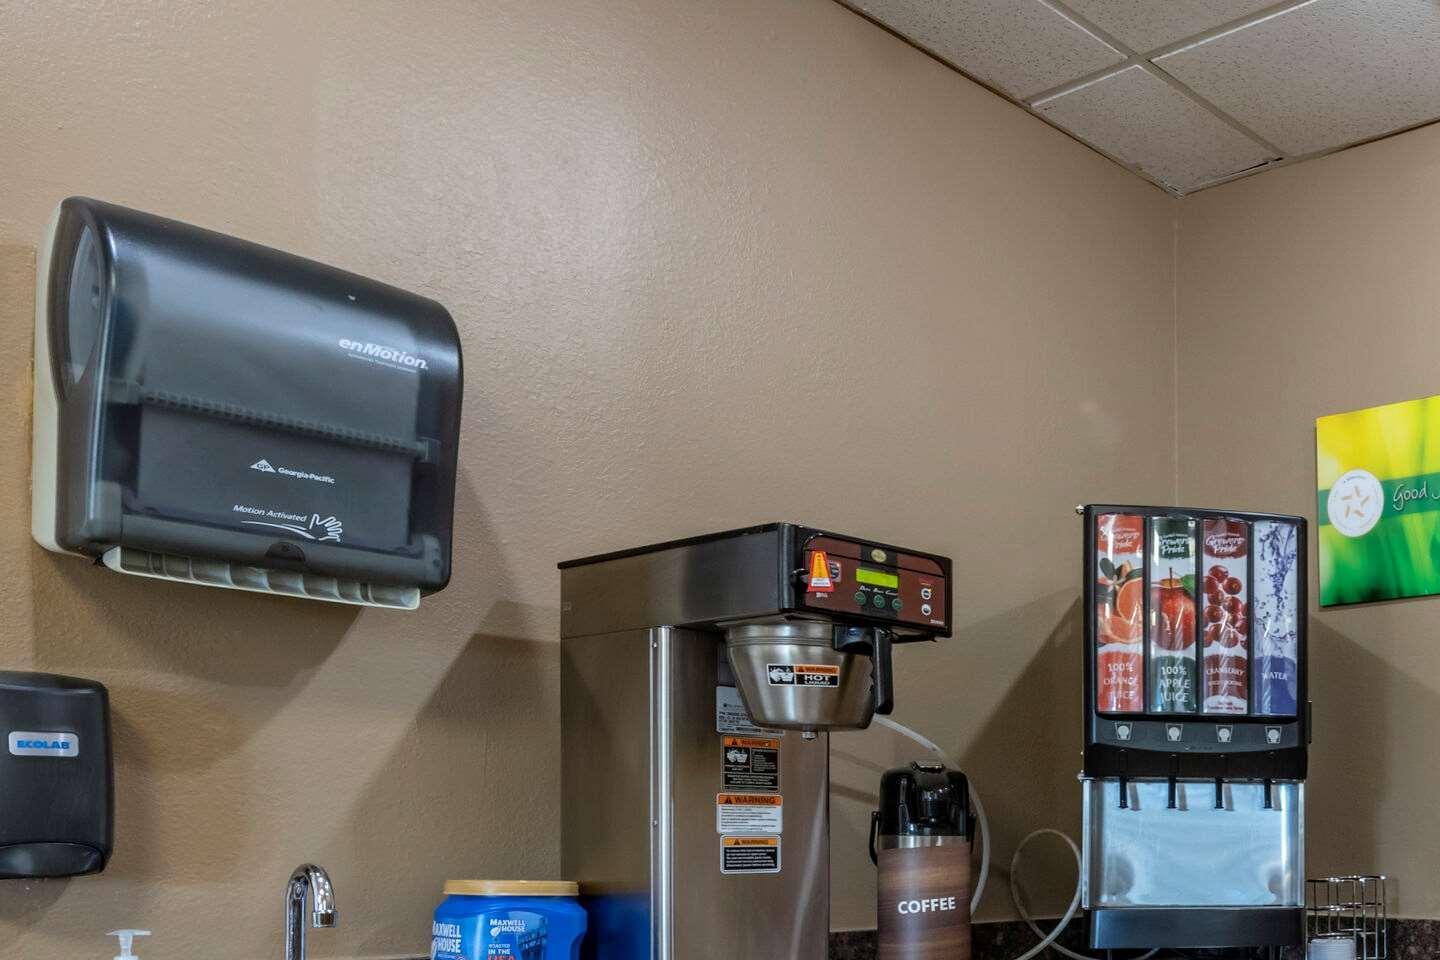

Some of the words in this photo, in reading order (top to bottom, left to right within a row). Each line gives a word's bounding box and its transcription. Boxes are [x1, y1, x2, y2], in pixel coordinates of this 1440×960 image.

[1392, 481, 1429, 511] Good
[233, 505, 265, 516] Motion
[266, 510, 308, 522] Activated
[1161, 666, 1187, 675] 100%
[1262, 671, 1288, 680] WATER
[1159, 678, 1191, 688] APPLE
[16, 740, 70, 750] ECOLAB
[735, 796, 776, 805] WARNING
[898, 896, 956, 914] COFFEE
[490, 918, 525, 926] MAXWELL
[437, 937, 462, 954] HOUSE
